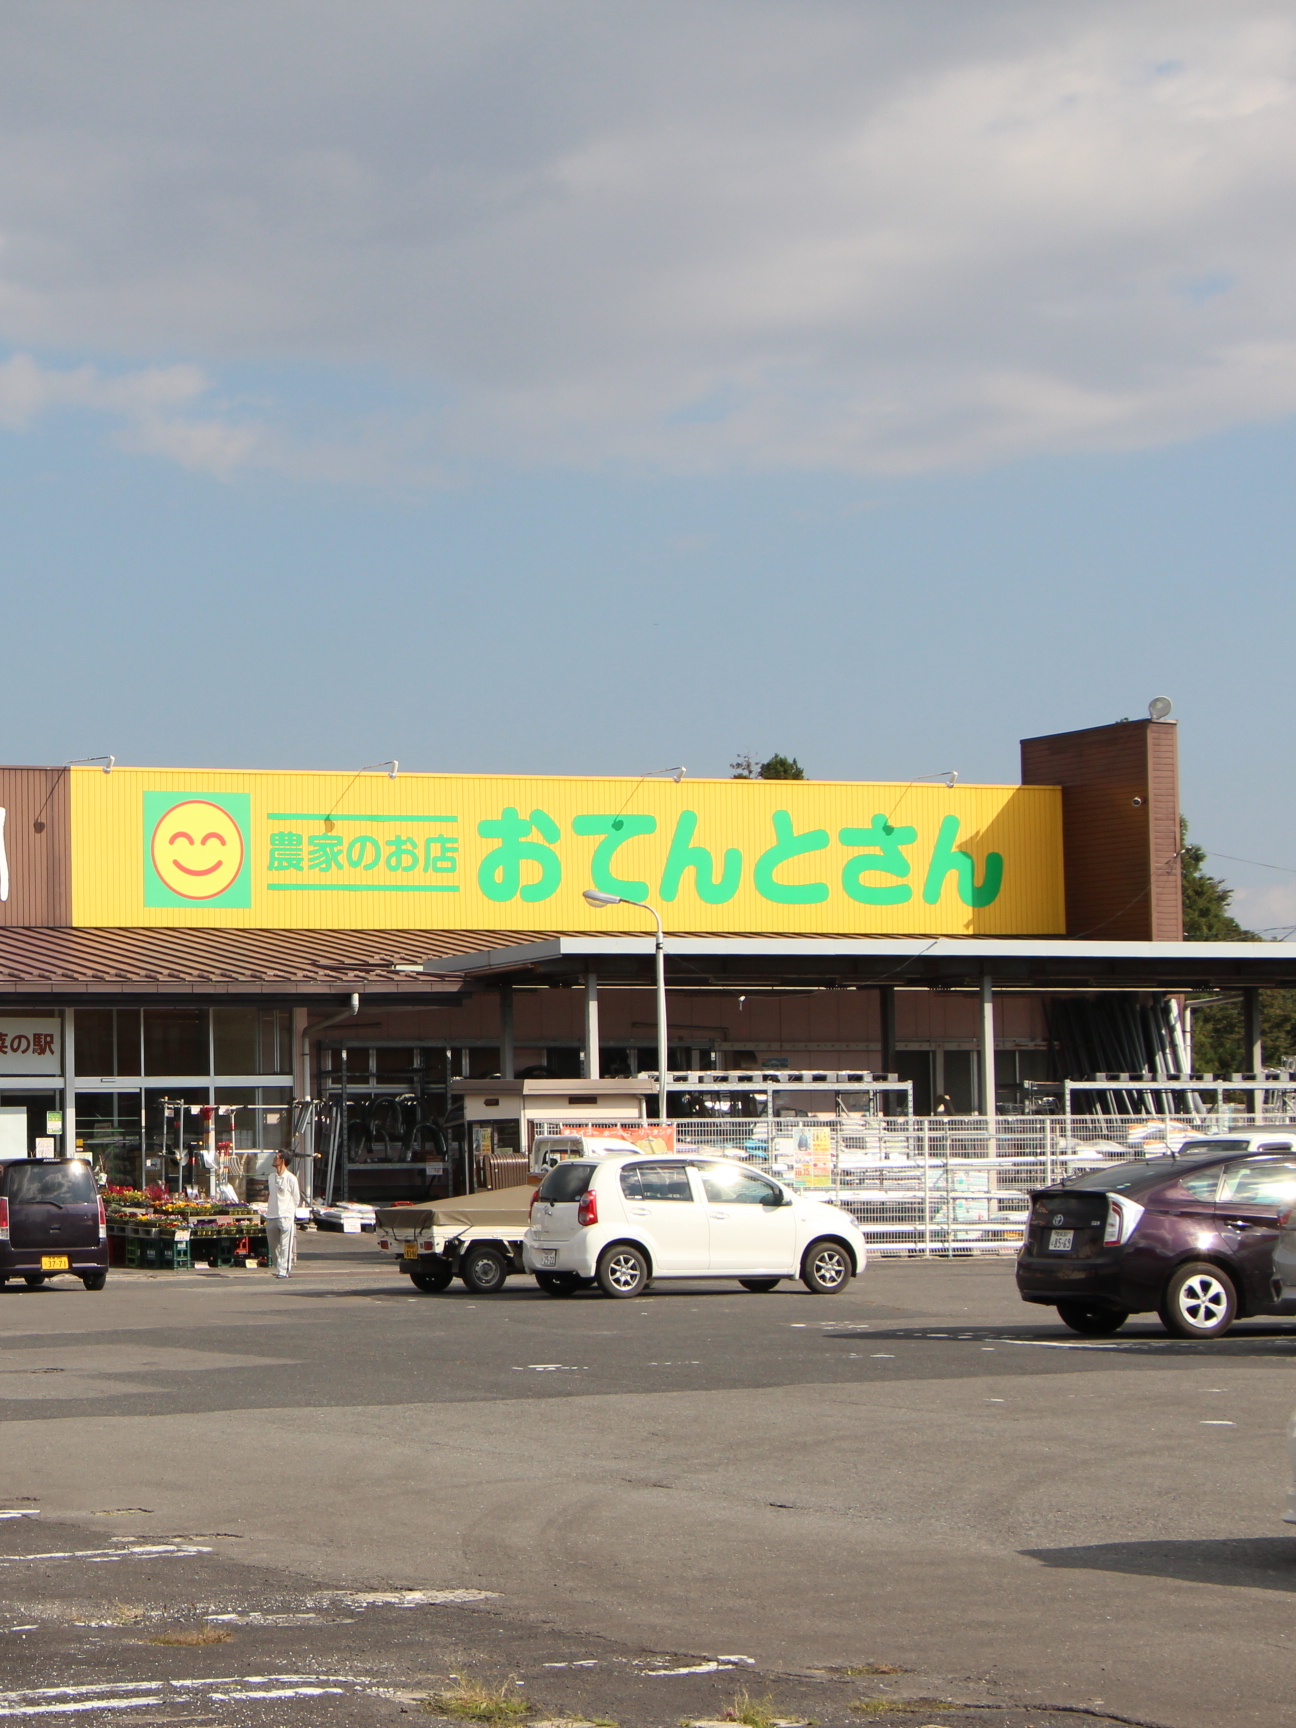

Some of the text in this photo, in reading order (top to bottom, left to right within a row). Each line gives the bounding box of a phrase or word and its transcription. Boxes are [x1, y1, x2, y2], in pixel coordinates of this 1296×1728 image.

[267, 832, 459, 875] 農家のお店
[477, 807, 1003, 909] おてんとさん
